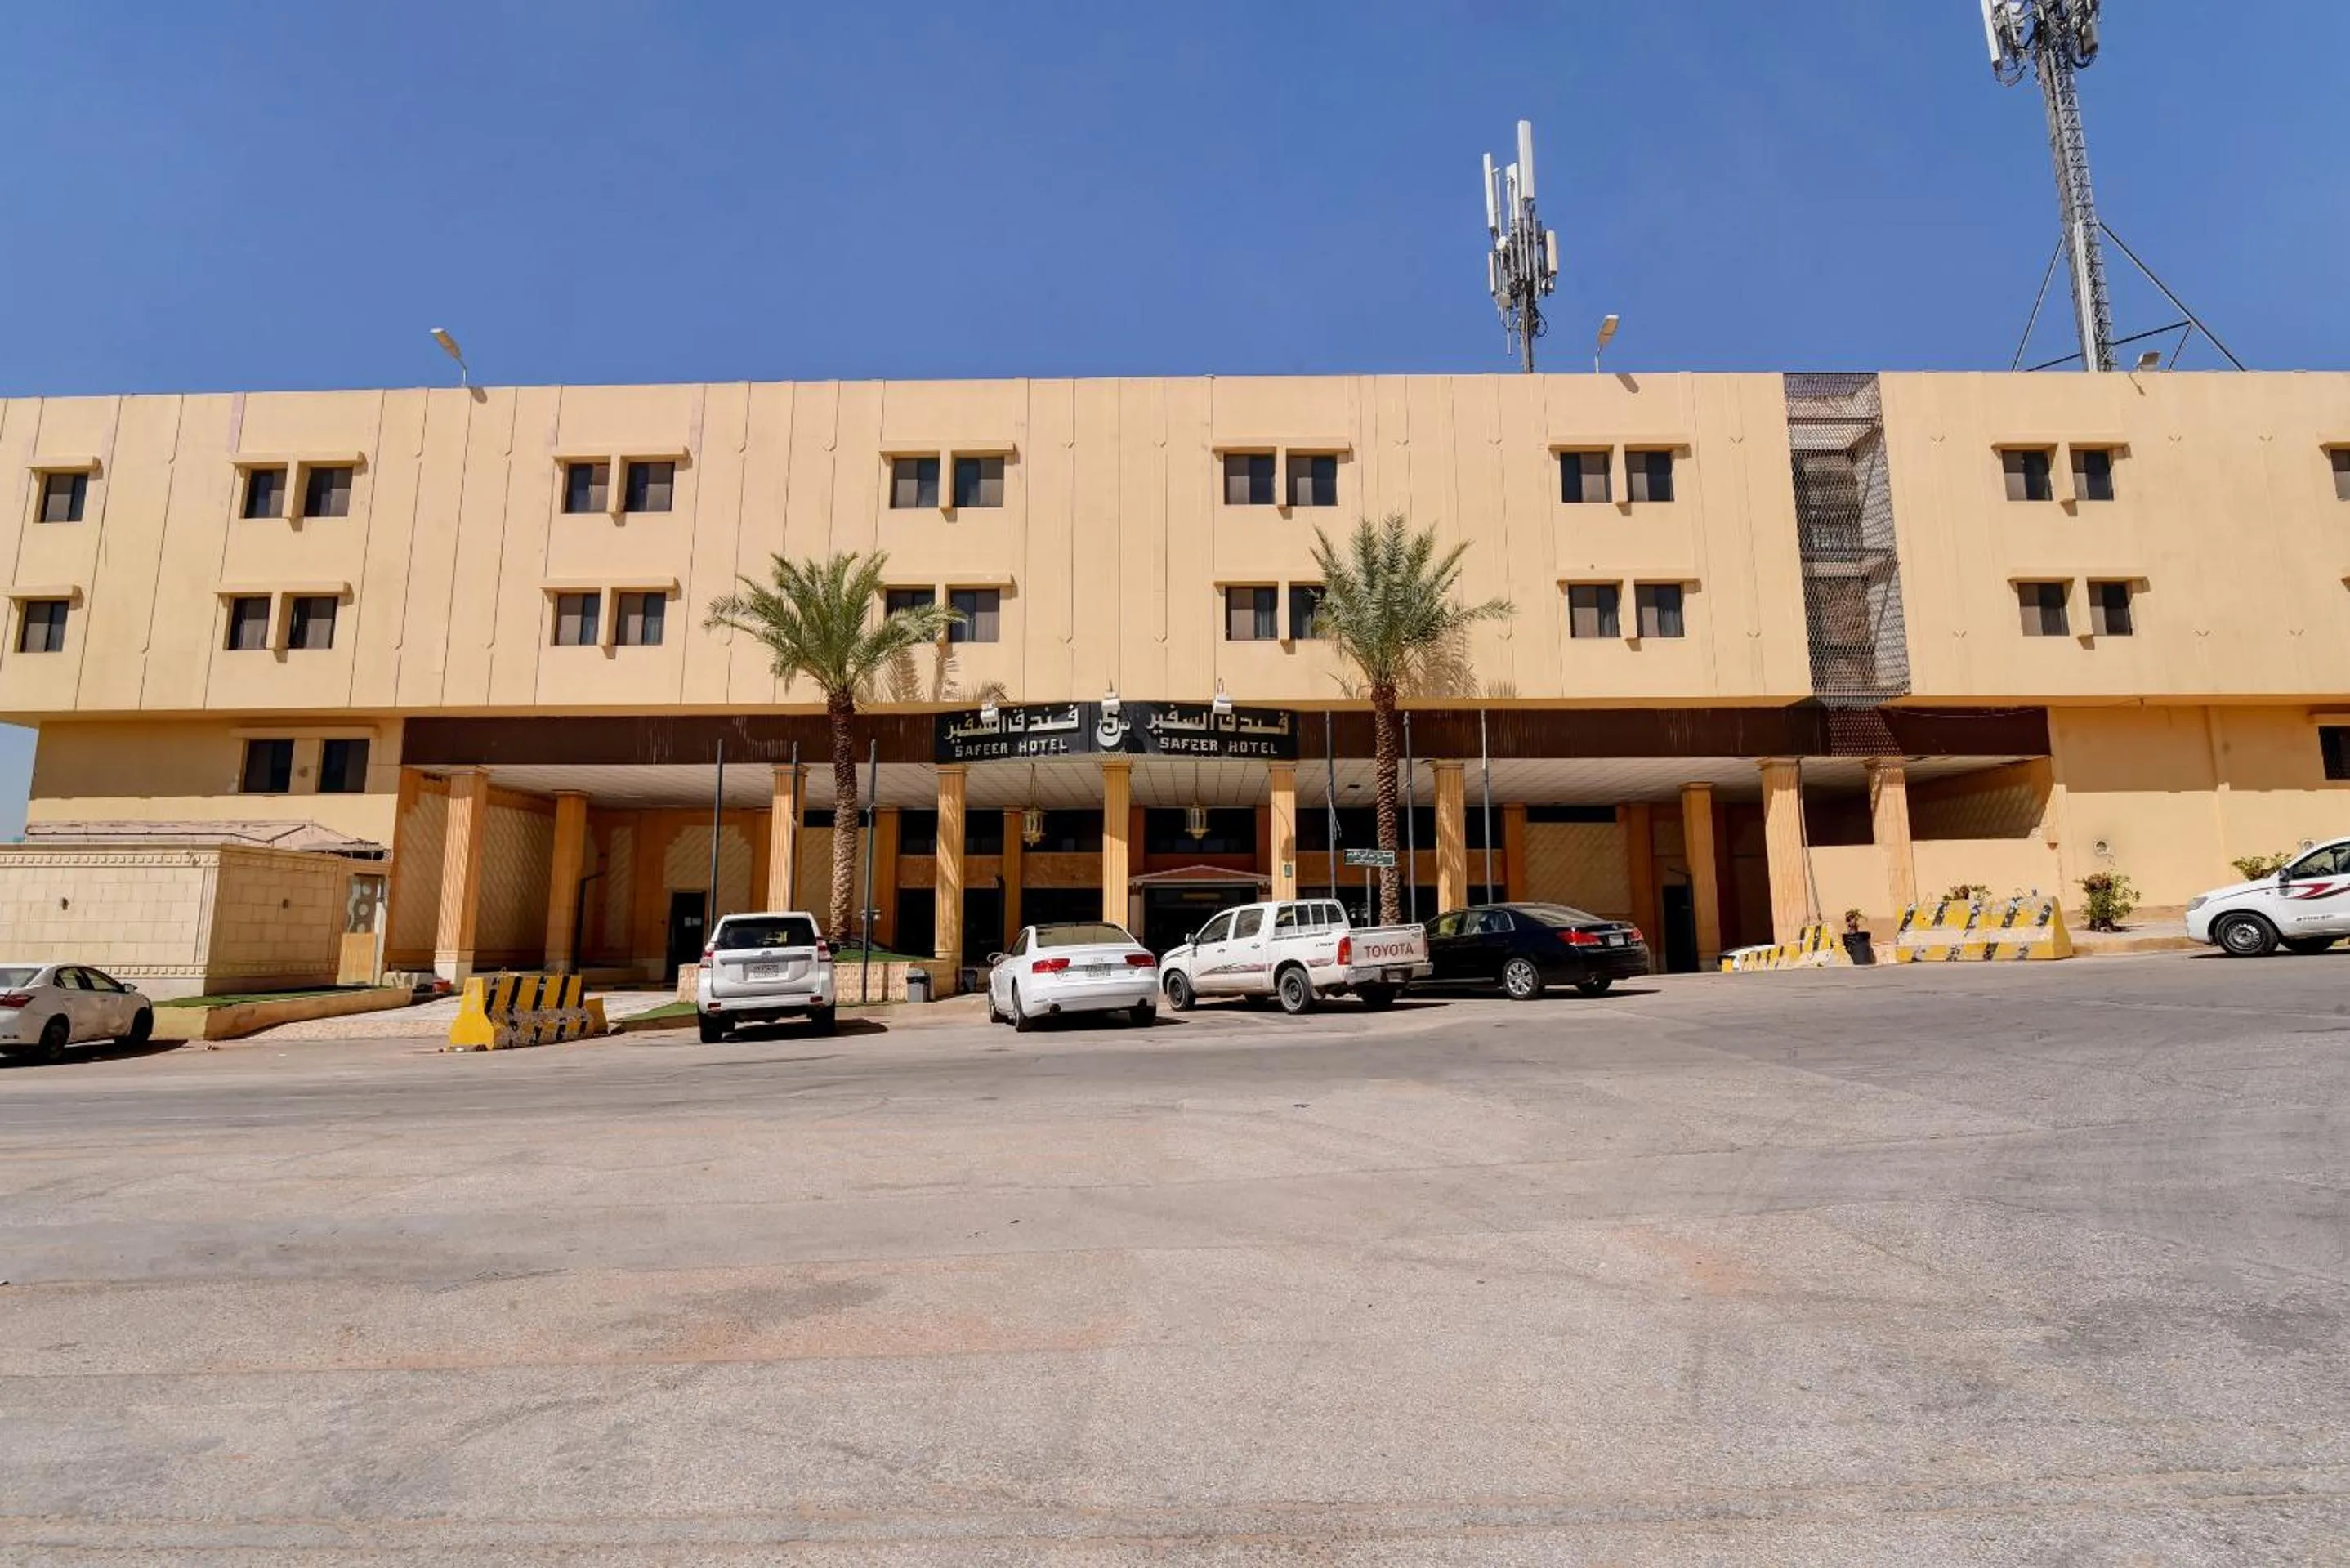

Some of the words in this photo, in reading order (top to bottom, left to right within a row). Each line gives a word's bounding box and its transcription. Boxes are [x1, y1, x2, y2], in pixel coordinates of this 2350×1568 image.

[1008, 704, 1079, 732] فندق
[1145, 704, 1214, 735] السفير
[954, 742, 1009, 758] SAFEER
[1019, 739, 1068, 753] HOTEL
[1159, 737, 1218, 751] SAFEER
[1228, 741, 1278, 754] HOTEL
[1364, 942, 1414, 958] TOYOTA
